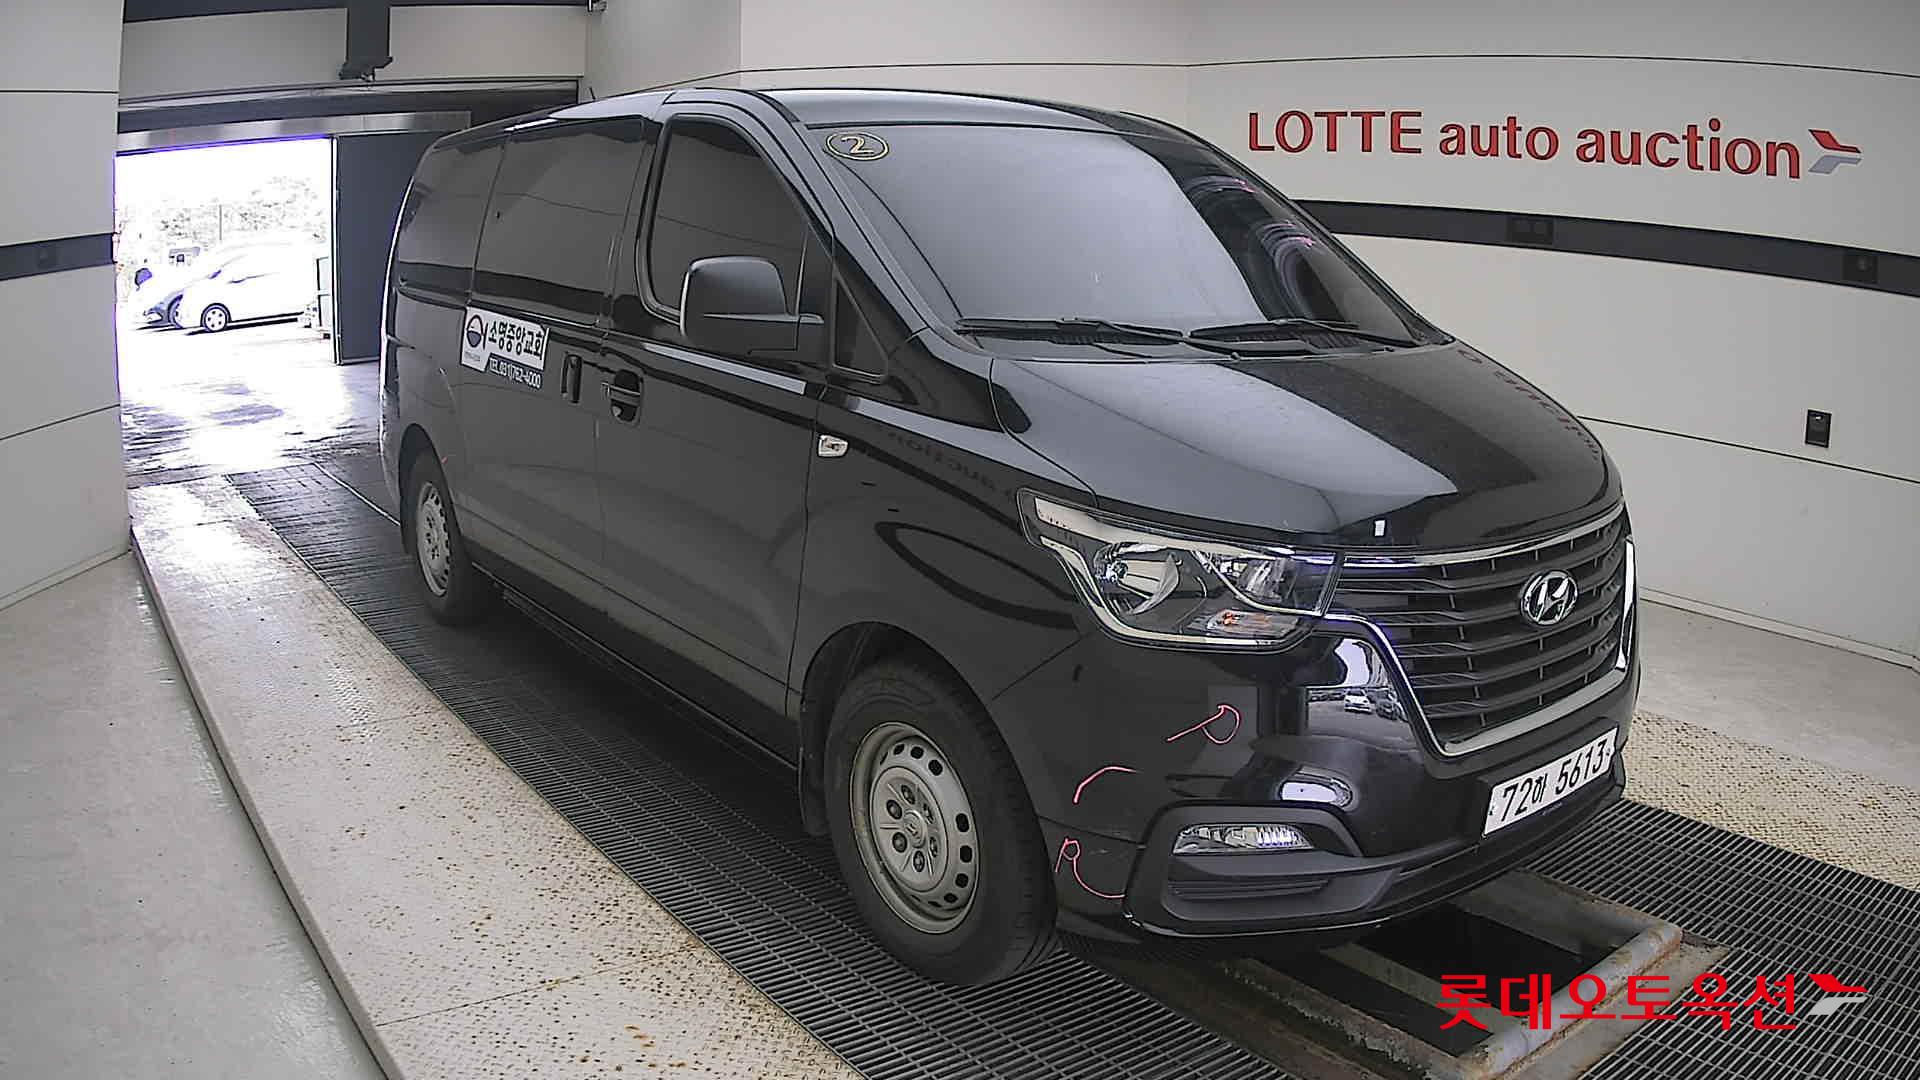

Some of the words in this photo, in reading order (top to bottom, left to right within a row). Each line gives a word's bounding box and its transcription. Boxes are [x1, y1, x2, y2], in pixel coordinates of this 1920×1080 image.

[1248, 111, 1423, 154] LOTTE
[1439, 115, 1559, 161] auto
[1576, 118, 1801, 180] auction
[488, 321, 544, 360] 소명중앙교회
[1554, 738, 1608, 795] 5613
